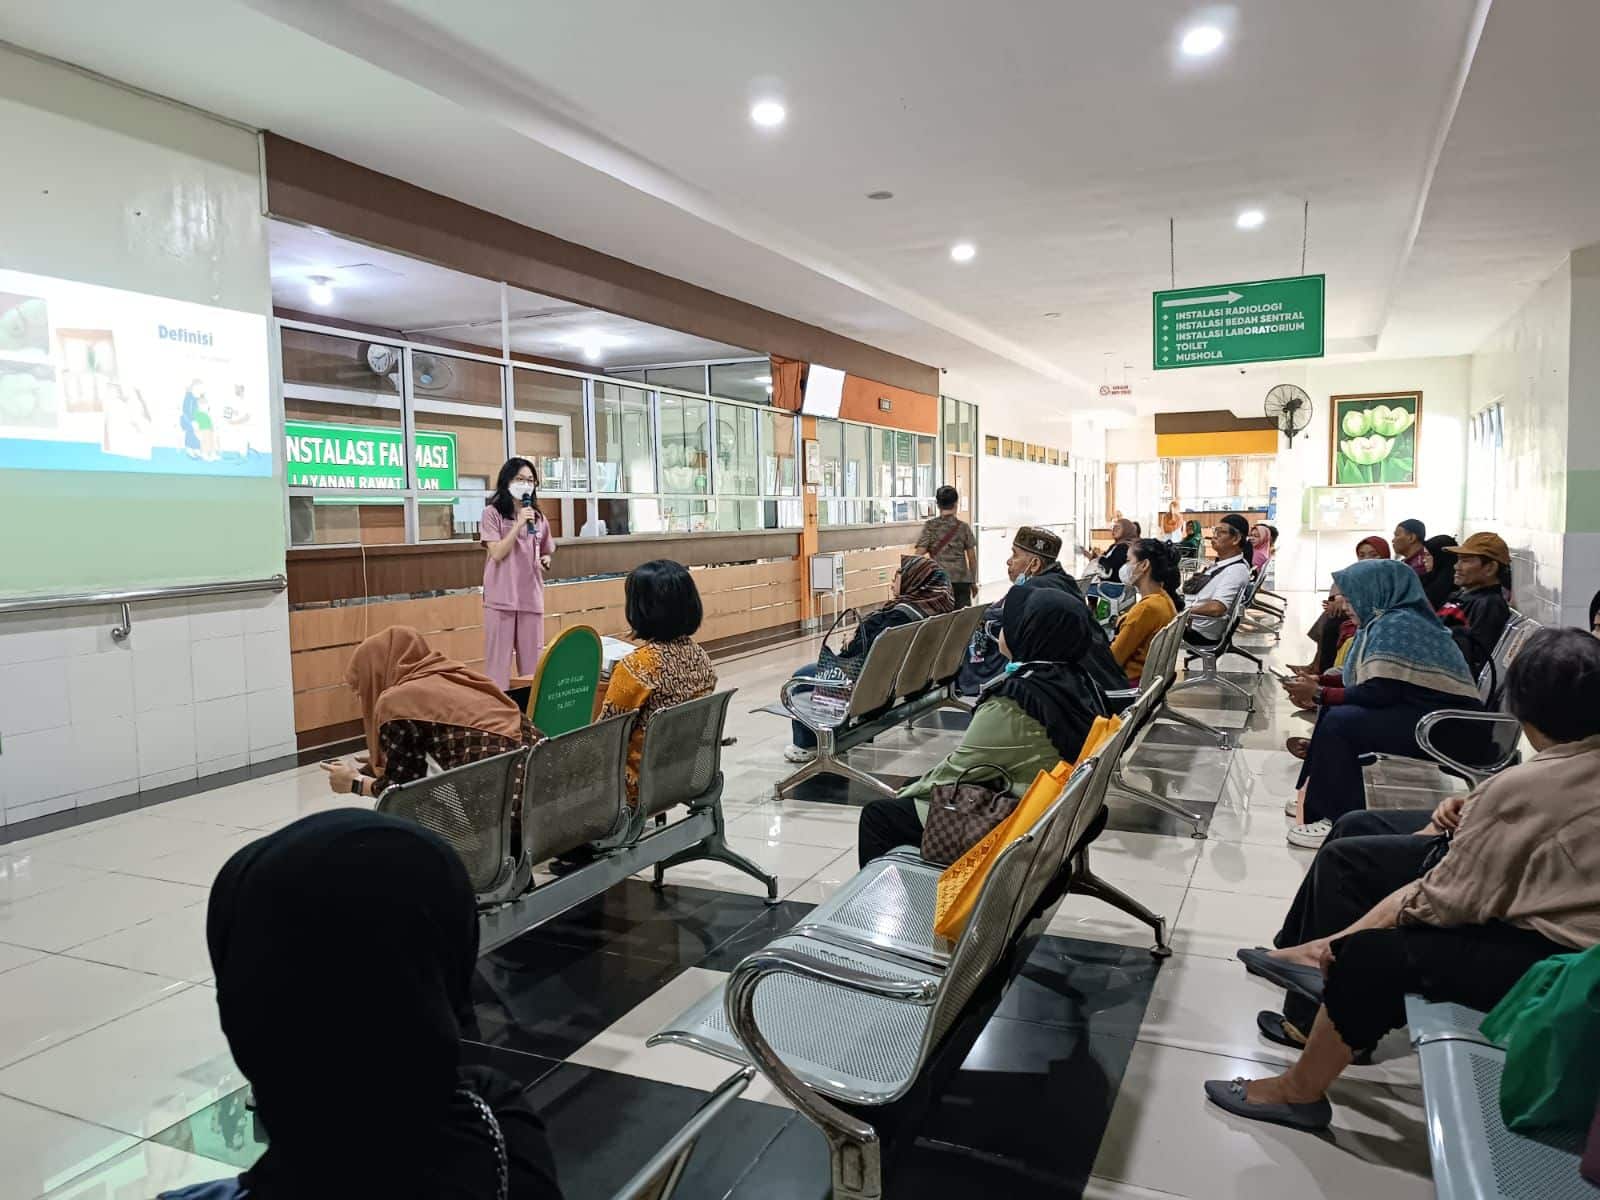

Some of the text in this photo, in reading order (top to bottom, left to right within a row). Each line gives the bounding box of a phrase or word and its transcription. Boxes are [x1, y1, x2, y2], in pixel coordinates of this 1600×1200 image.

[1175, 302, 1282, 321] INSTALASI RADIOLOGI
[1175, 311, 1305, 331] INSTALASI BEDAH SENTRAL
[158, 324, 214, 347] Definisi
[1175, 322, 1305, 341] INSTALASI LABORATORIUM
[1175, 341, 1208, 351] TOILET
[1175, 351, 1223, 362] MUSHOLA
[286, 436, 375, 465] NSTALASI
